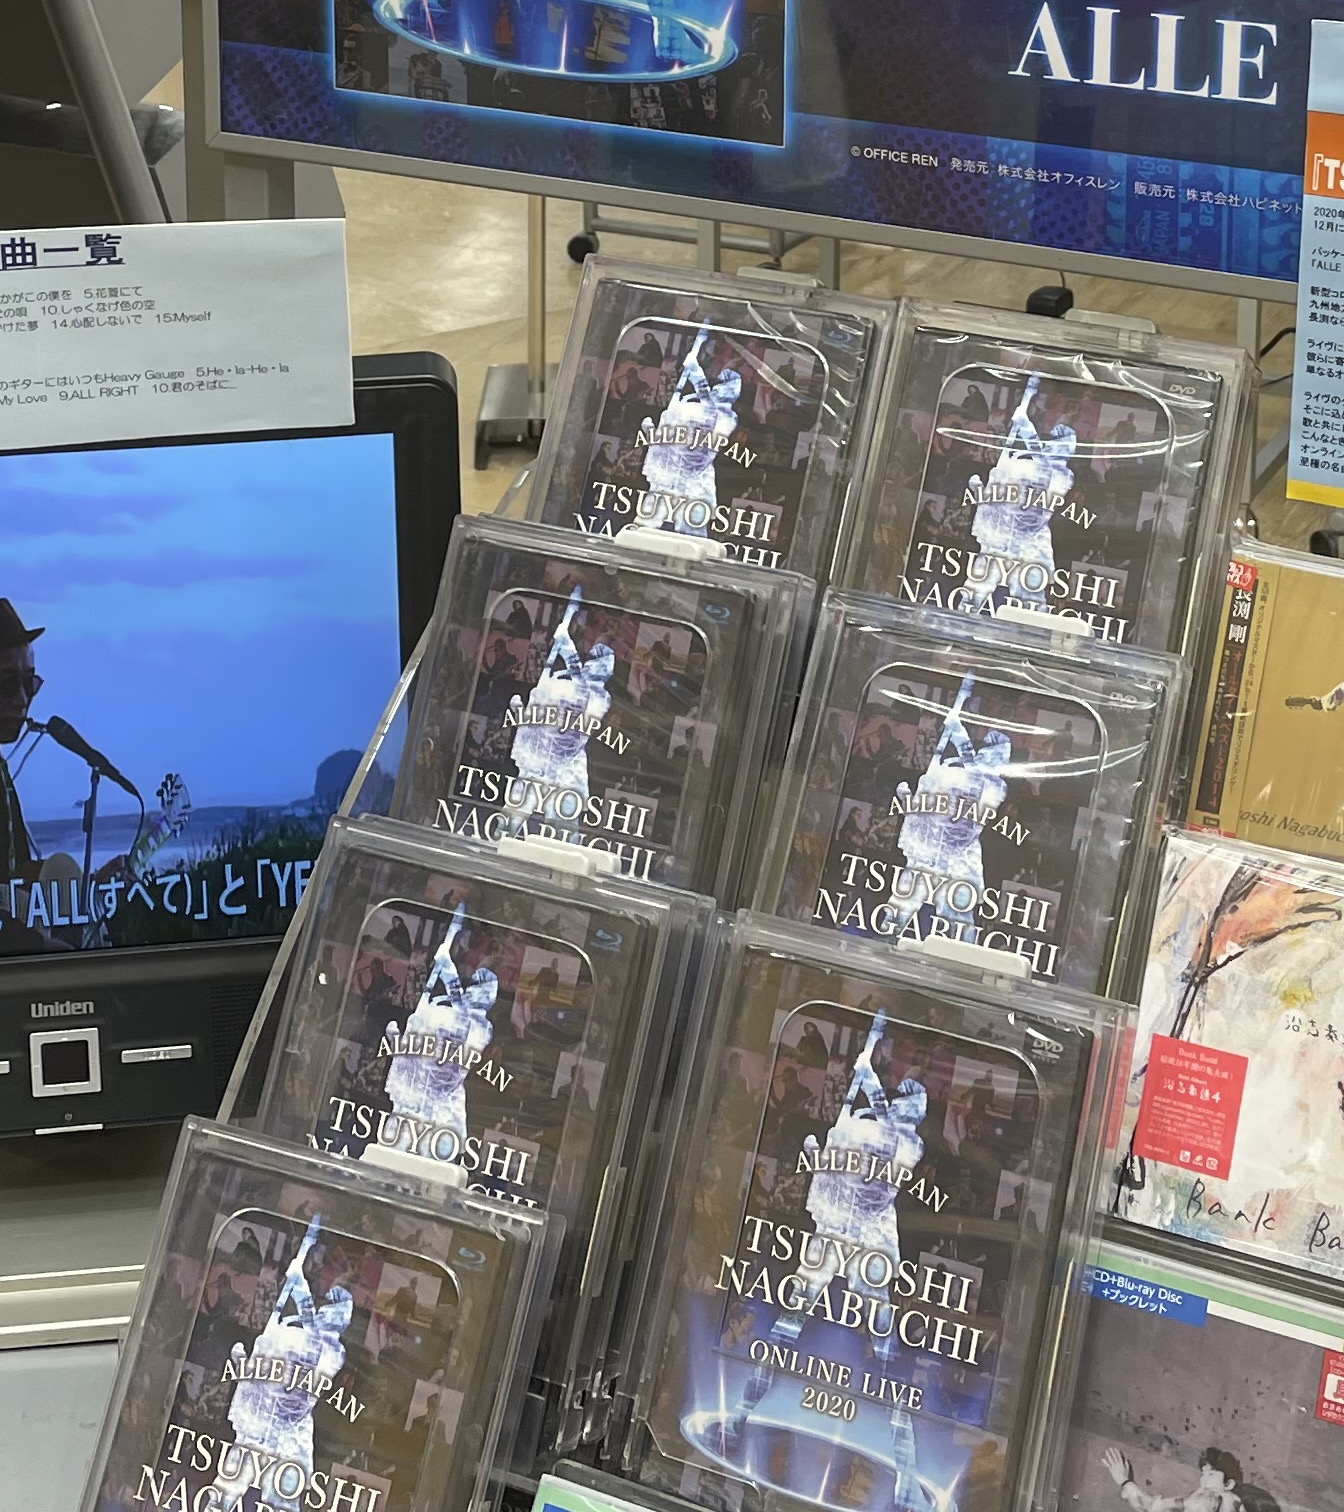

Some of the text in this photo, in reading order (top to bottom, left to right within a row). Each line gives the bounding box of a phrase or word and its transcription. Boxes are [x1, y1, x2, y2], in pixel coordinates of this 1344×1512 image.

[1009, 2, 1280, 106] ALLE
[864, 146, 909, 163] OFFICE
[912, 152, 939, 168] REN
[1311, 259, 1341, 273] 「ALLE
[16, 393, 47, 405] Love
[99, 385, 138, 398] RIGHT
[634, 426, 757, 469] ALLE JAPAN
[592, 481, 775, 542] TSUYOSHI
[961, 485, 1097, 530] ALLE JAPAN
[917, 541, 1120, 610] TSUYOSHI
[502, 705, 631, 755] ALLE JAPAN
[457, 763, 651, 839] TSUYOSHI
[888, 794, 1030, 846] ALLE JAPAN
[839, 852, 1052, 933] TSUYOSHI
[29, 999, 94, 1018] Uniden
[376, 1035, 514, 1093] ALLE JAPAN
[1031, 1037, 1065, 1053] DVD
[328, 1095, 532, 1187] TSUYOSHI
[795, 1149, 950, 1214] ALLE JAPAN
[1186, 1177, 1278, 1235] Bank
[744, 1214, 975, 1315] TSUYOSHI
[713, 1255, 985, 1366] NAGABUCHI
[1157, 1287, 1184, 1306] Disc
[220, 1356, 365, 1424] ALLE JAPAN
[749, 1338, 924, 1411] ONLINE LIVE
[801, 1387, 857, 1422] 2020
[167, 1424, 381, 1512] TSUYOSHI
